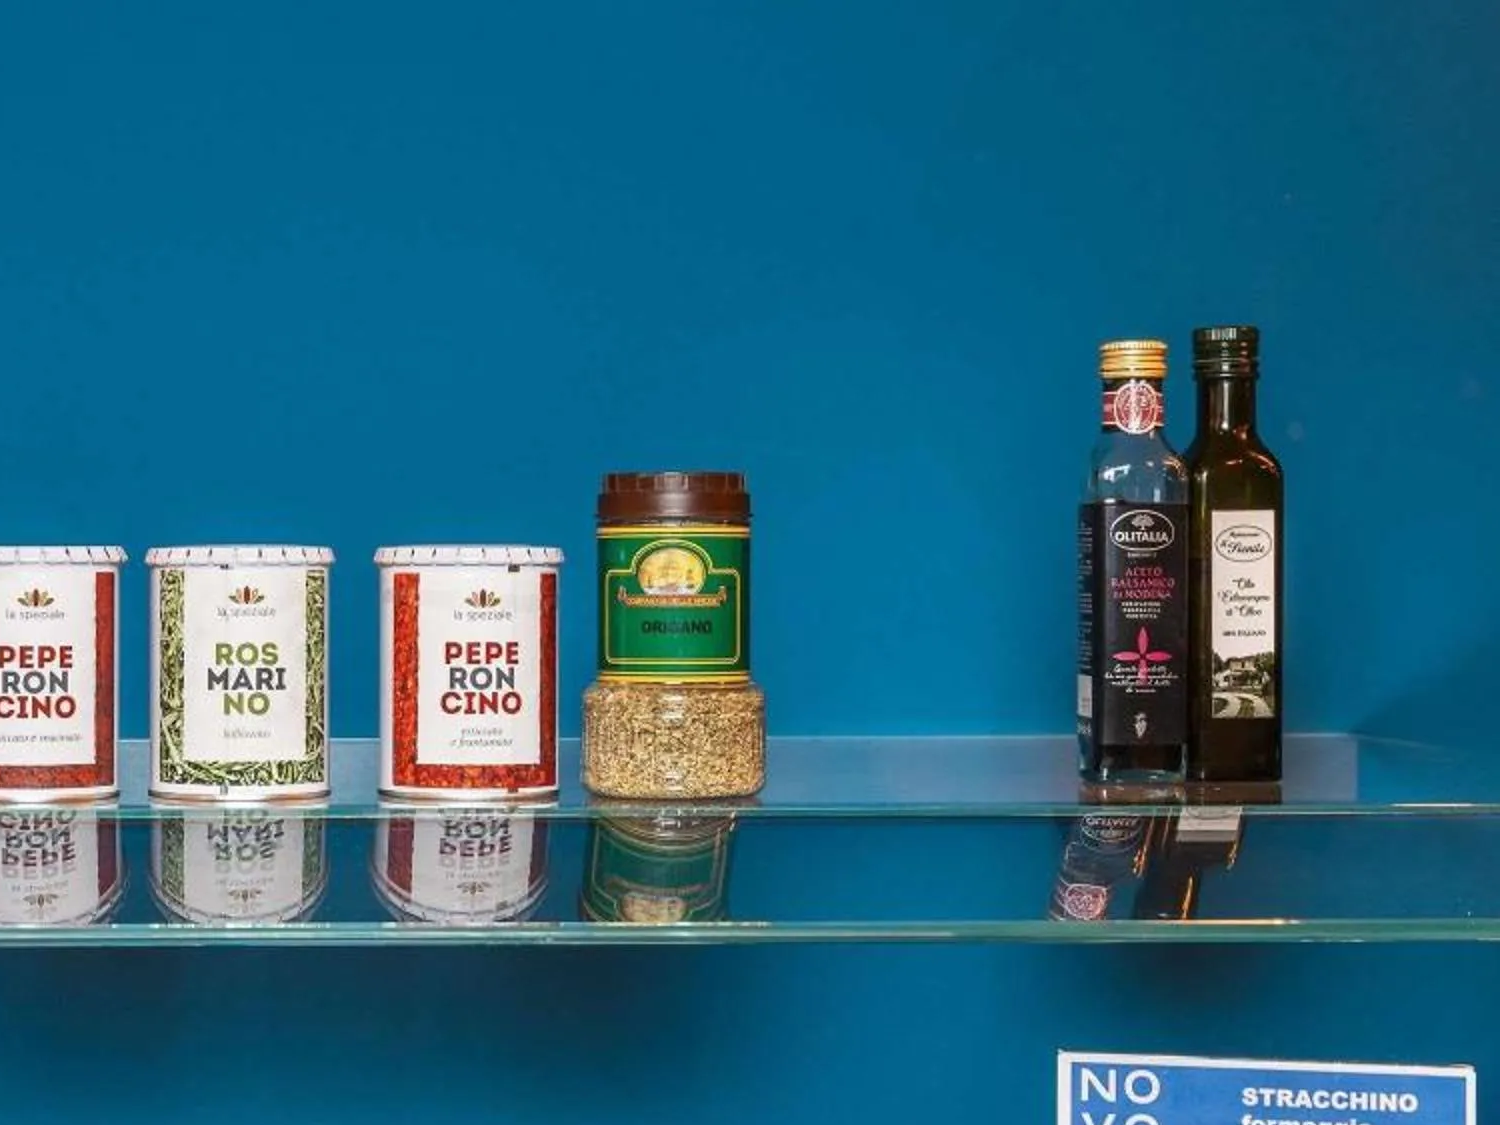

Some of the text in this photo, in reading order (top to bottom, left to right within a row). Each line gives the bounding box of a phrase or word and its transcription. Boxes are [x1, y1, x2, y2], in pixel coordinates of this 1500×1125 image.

[1114, 531, 1169, 543] OLITALIA
[642, 620, 712, 634] ORIGANO
[216, 643, 278, 666] ROS
[446, 642, 518, 664] PEPE
[2, 671, 68, 694] RON
[208, 668, 286, 690] MARI
[450, 667, 514, 690] RON
[224, 692, 270, 715] NO
[441, 692, 522, 714] CINO
[1082, 1068, 1160, 1104] NO
[1243, 1088, 1418, 1112] STRACCHINO
